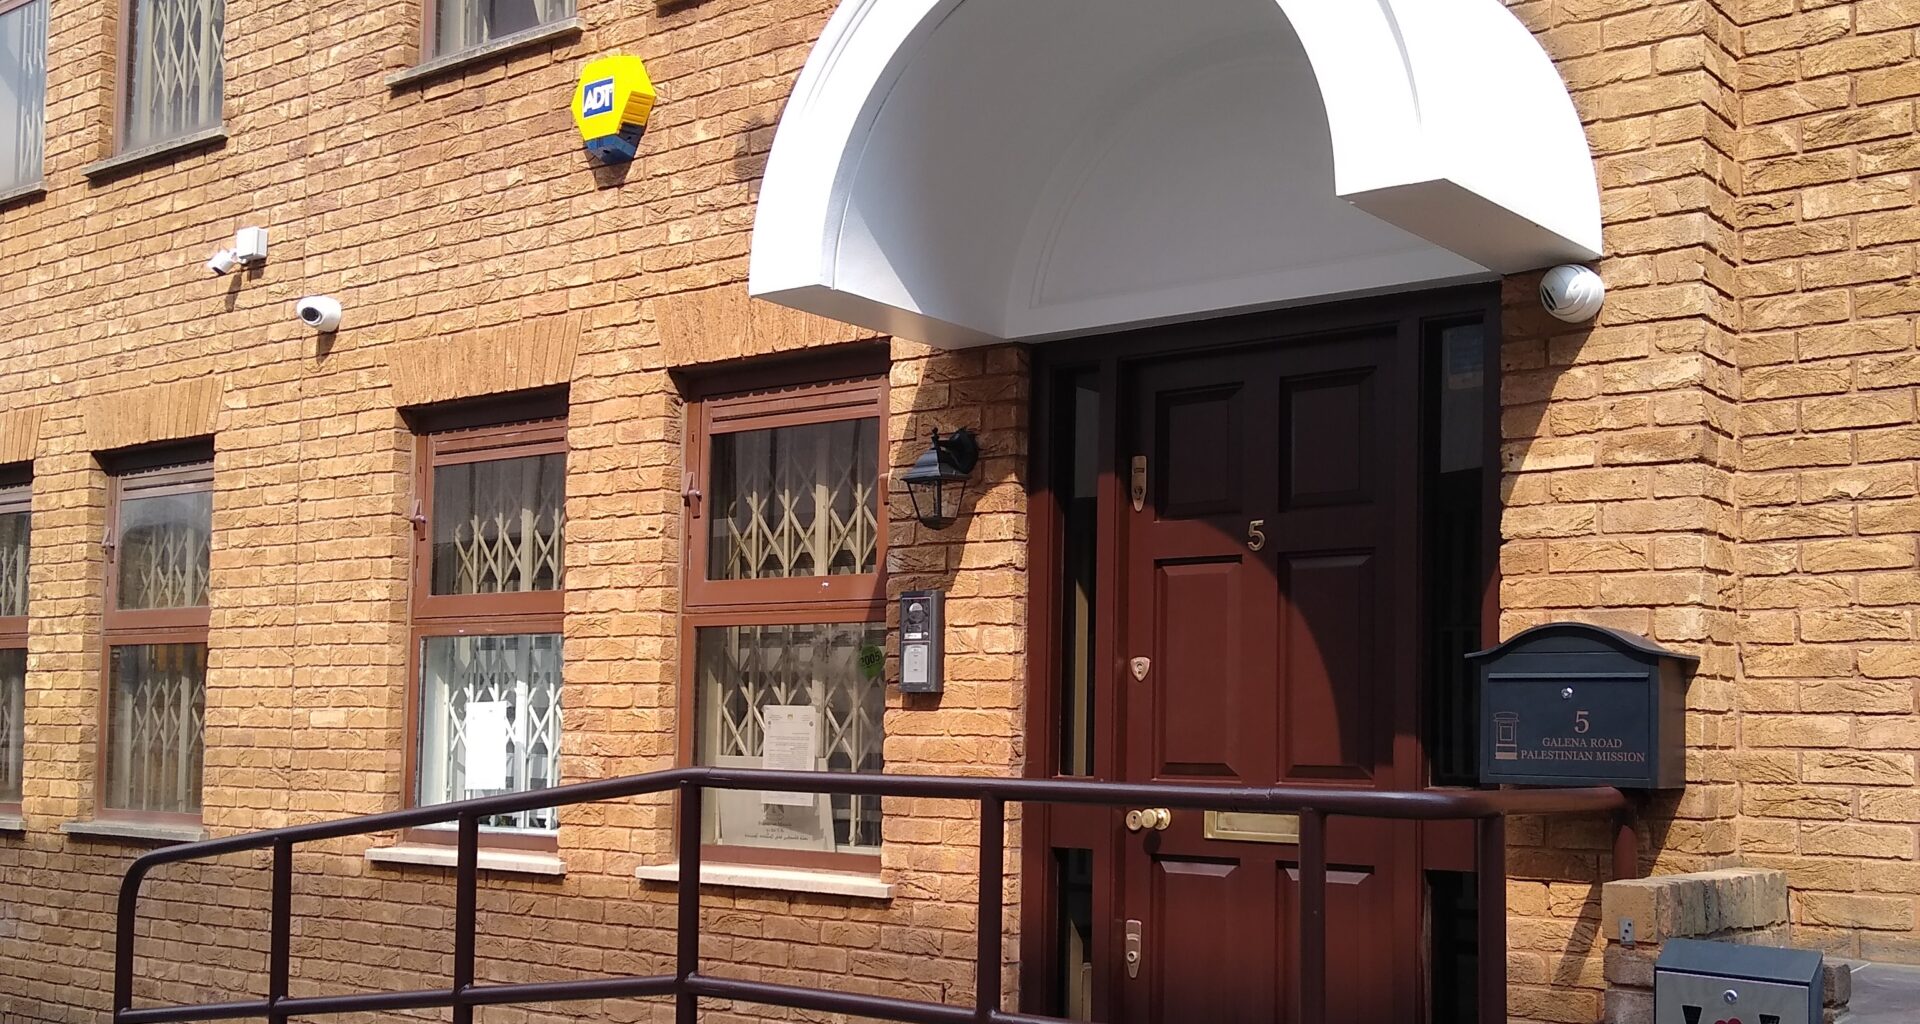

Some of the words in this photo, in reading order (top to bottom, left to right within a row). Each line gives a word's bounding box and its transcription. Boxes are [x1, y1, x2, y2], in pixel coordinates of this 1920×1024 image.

[583, 82, 613, 113] ADT
[1247, 519, 1266, 552] 5
[1574, 710, 1590, 733] 5
[1542, 737, 1586, 748] GALENA
[1591, 738, 1622, 748] ROAD
[1521, 750, 1593, 761] PALESTINIAN
[1596, 751, 1645, 762] MISSION
